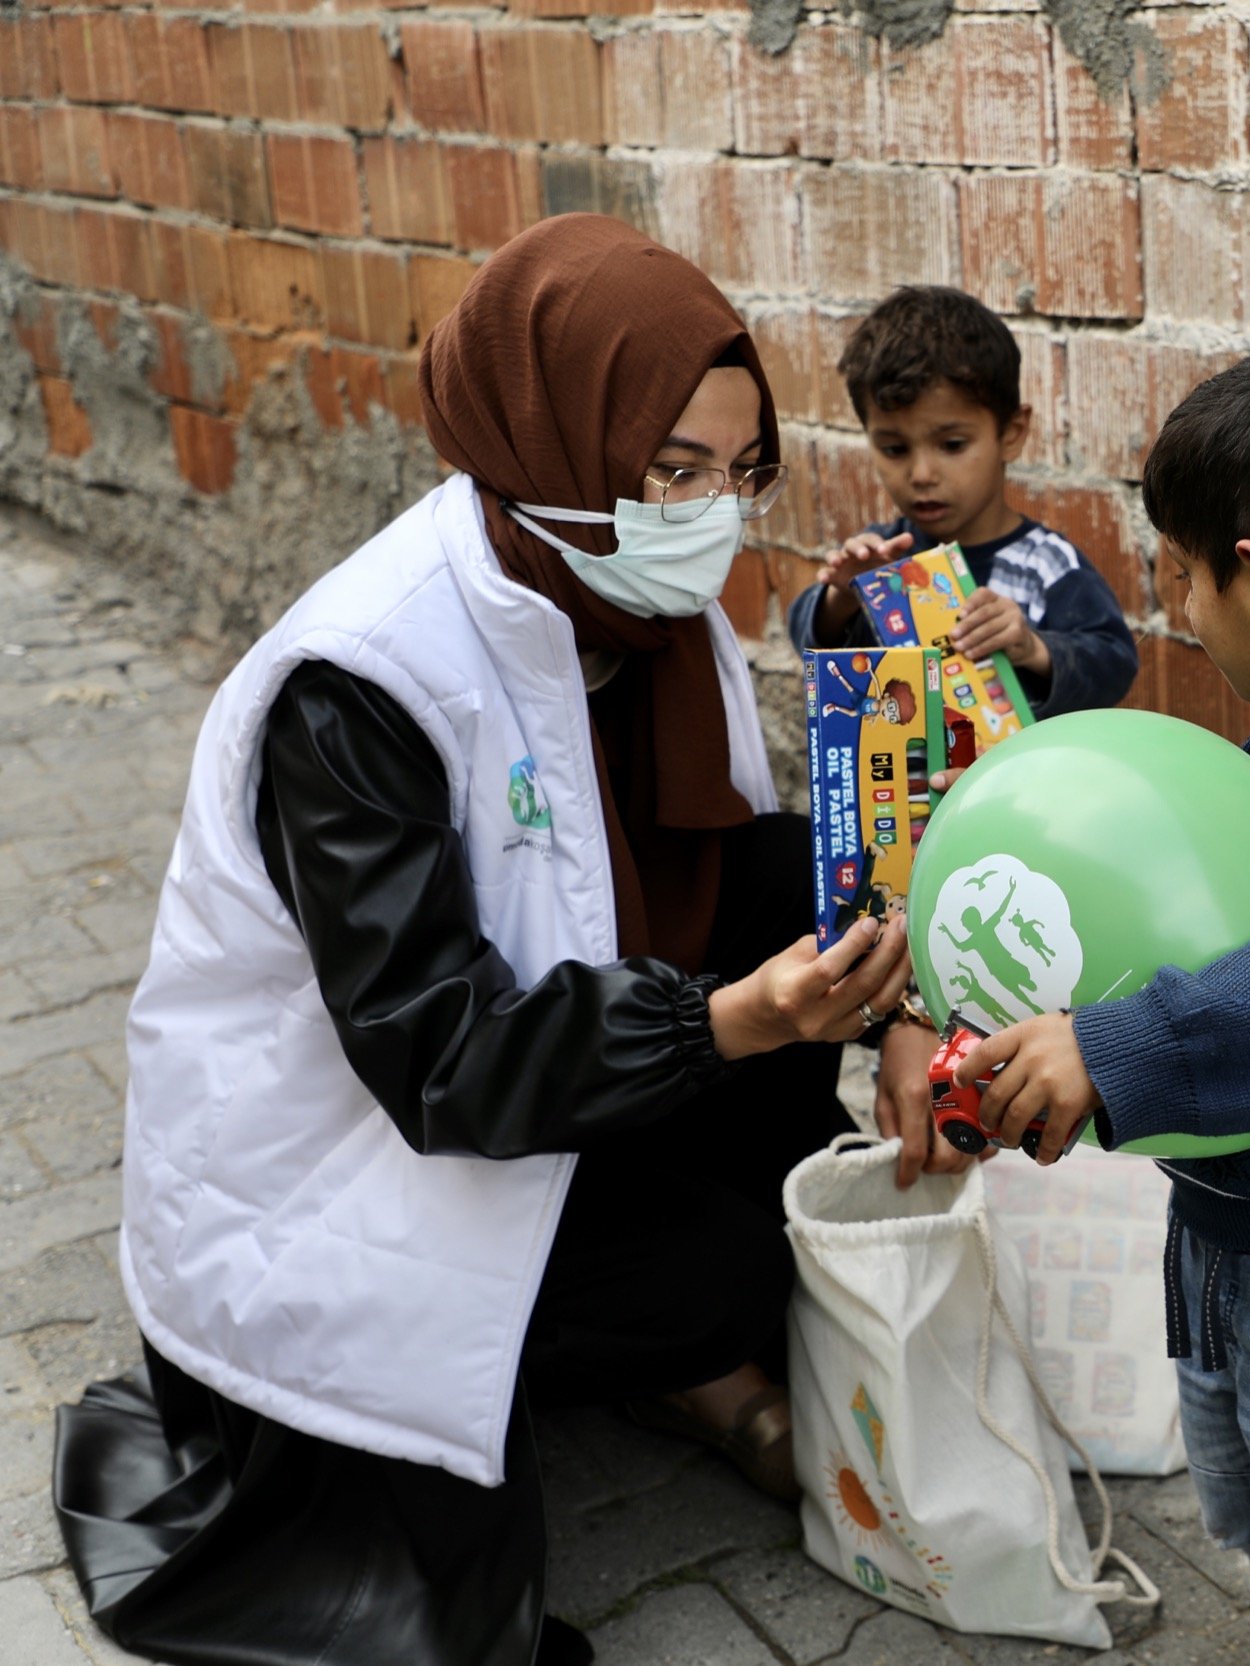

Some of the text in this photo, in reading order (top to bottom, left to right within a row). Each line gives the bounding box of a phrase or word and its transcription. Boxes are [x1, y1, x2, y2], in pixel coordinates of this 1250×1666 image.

[810, 728, 819, 782] PASTEL
[816, 862, 826, 916] PASTEL
[827, 748, 843, 858] OIL PASTEL
[841, 746, 856, 858] PASTEL BOYA
[842, 867, 854, 885] 12
